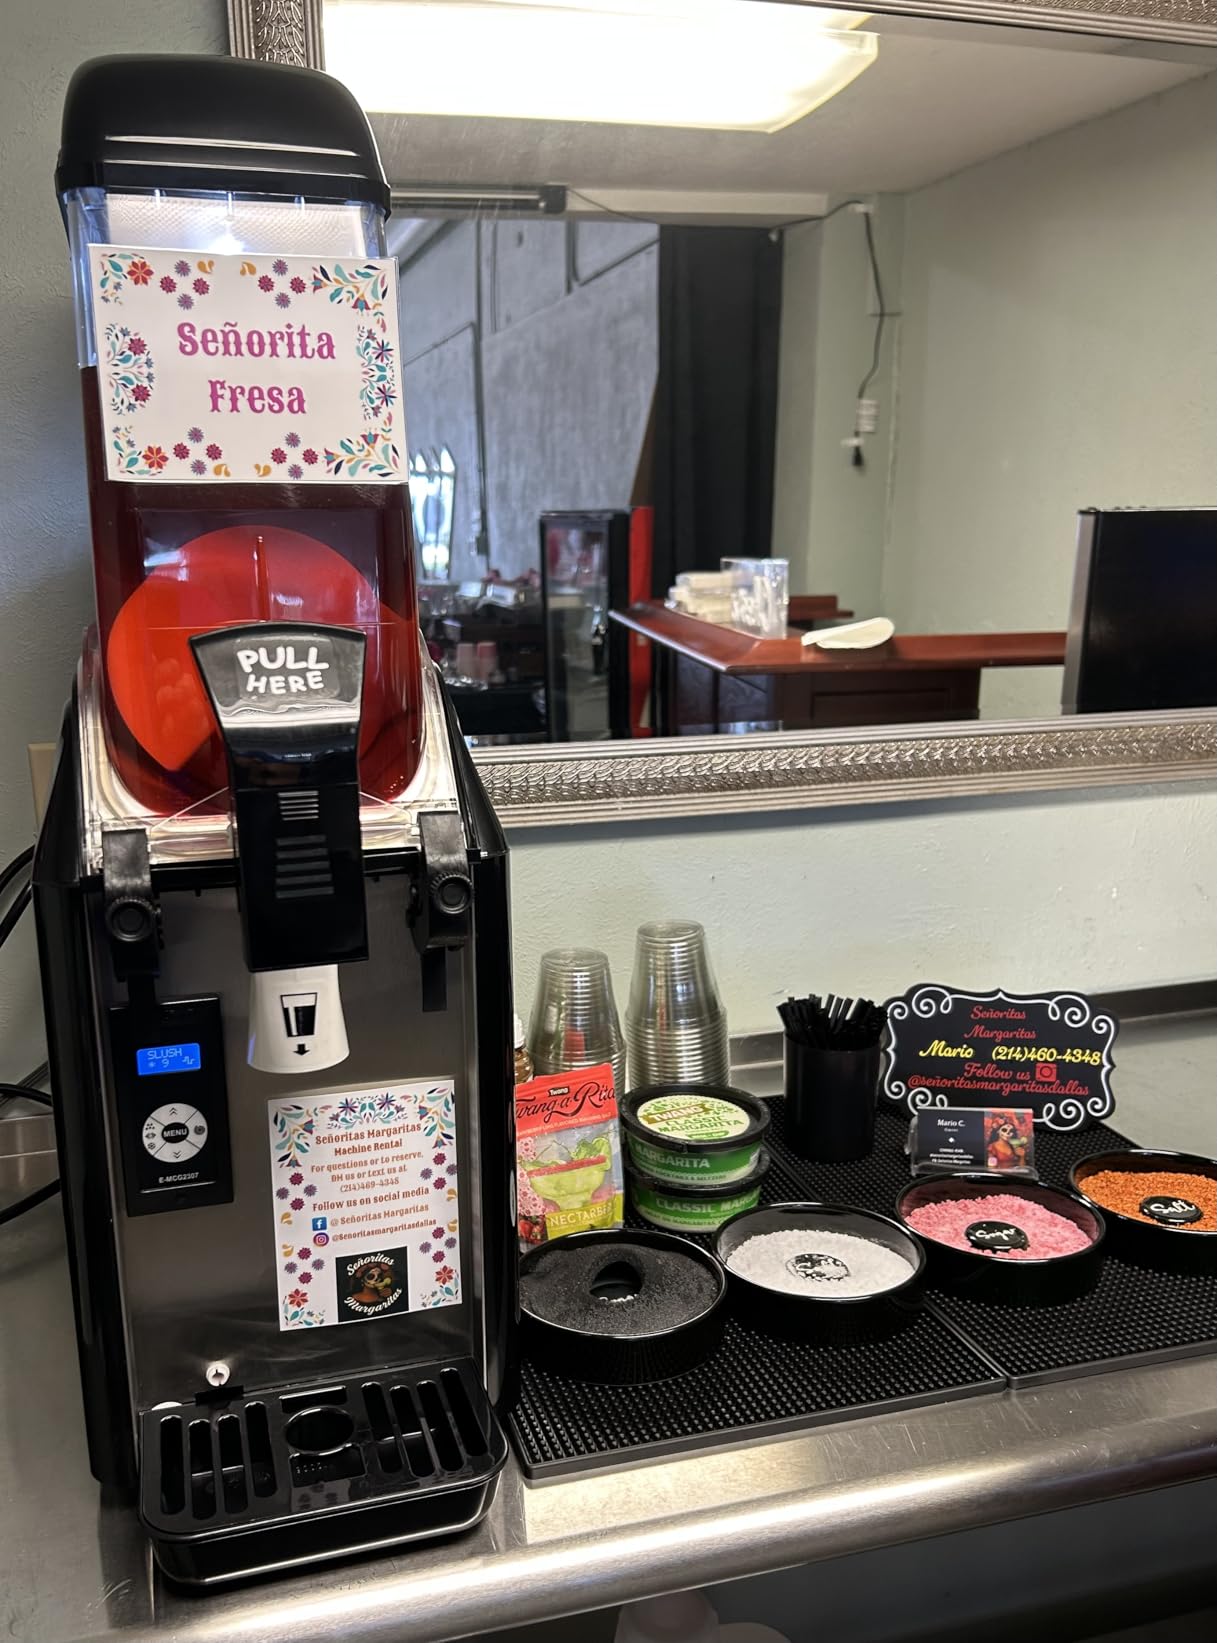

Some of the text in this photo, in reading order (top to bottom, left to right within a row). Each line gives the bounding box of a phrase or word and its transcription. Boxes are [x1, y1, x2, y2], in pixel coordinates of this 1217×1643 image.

[177, 321, 337, 361] Señorita
[208, 379, 307, 415] Fresa
[236, 646, 330, 673] PULL
[246, 670, 325, 695] HERE
[970, 1005, 1026, 1020] Señoritas
[963, 1024, 1037, 1042] Margaritas
[147, 1047, 183, 1060] SLUSH
[918, 1039, 1102, 1066] Mario (214)460-4348
[963, 1062, 1031, 1081] Follow us
[652, 1104, 703, 1121] TWANG
[163, 1126, 188, 1138] MENU
[658, 1120, 744, 1133] MARGARITA
[937, 1119, 958, 1127] Mario
[315, 1123, 422, 1145] Señoritas Margaritas
[334, 1138, 403, 1157] Machine Rental
[635, 1144, 711, 1168] MARGARITA
[311, 1164, 325, 1173] For
[326, 1158, 369, 1173] questions
[370, 1157, 379, 1166] or
[380, 1154, 390, 1164] to
[345, 1172, 355, 1181] us
[357, 1170, 367, 1180] or
[368, 1166, 386, 1178] text
[387, 1165, 397, 1175] us
[398, 1164, 408, 1174] at
[312, 1186, 430, 1212] Follow us on social media
[340, 1211, 382, 1225] Señoritas
[383, 1203, 429, 1218] Margaritas
[346, 1252, 395, 1276] Señoritas
[344, 1288, 402, 1316] Margaritas
